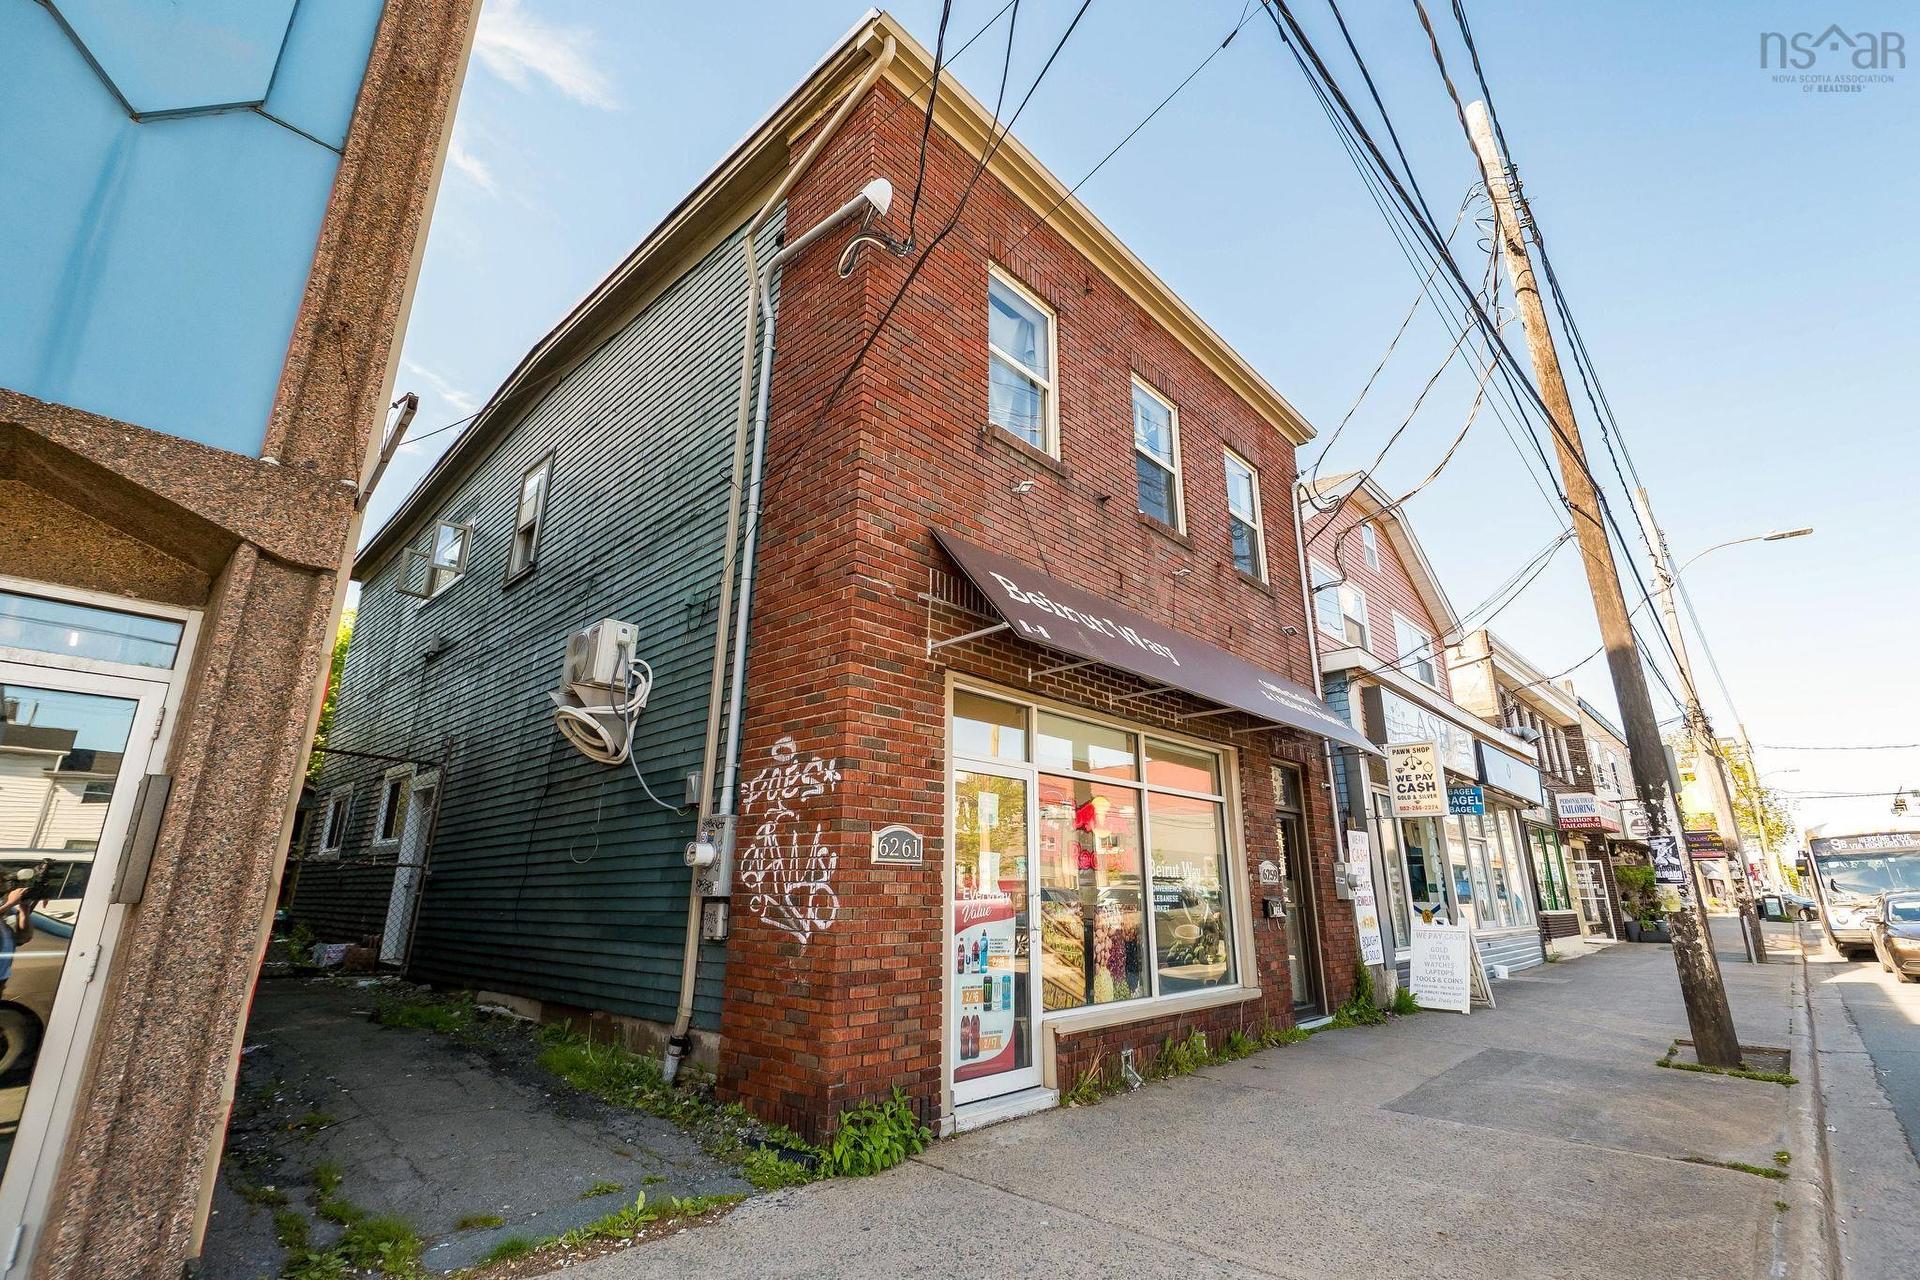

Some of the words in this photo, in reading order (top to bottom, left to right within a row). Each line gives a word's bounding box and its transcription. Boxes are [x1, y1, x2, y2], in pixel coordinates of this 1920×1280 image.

[988, 571, 1115, 639] Beirut
[1102, 617, 1181, 667] Way
[1412, 746, 1430, 754] SHOP
[1395, 774, 1412, 782] WE
[1415, 773, 1434, 781] PAY
[1448, 788, 1476, 796] BAGEL
[1449, 796, 1483, 805] AGEL
[1560, 803, 1596, 814] TAILORING
[1561, 816, 1593, 824] FASHION
[879, 836, 920, 858] 6261
[1262, 868, 1278, 881] 6259
[961, 902, 993, 923] Value
[1416, 931, 1427, 939] WE
[1428, 932, 1443, 940] PAY
[1424, 961, 1455, 969] WATCHES
[1425, 968, 1455, 976] LAPTOPS
[1416, 975, 1436, 983] TOOLS
